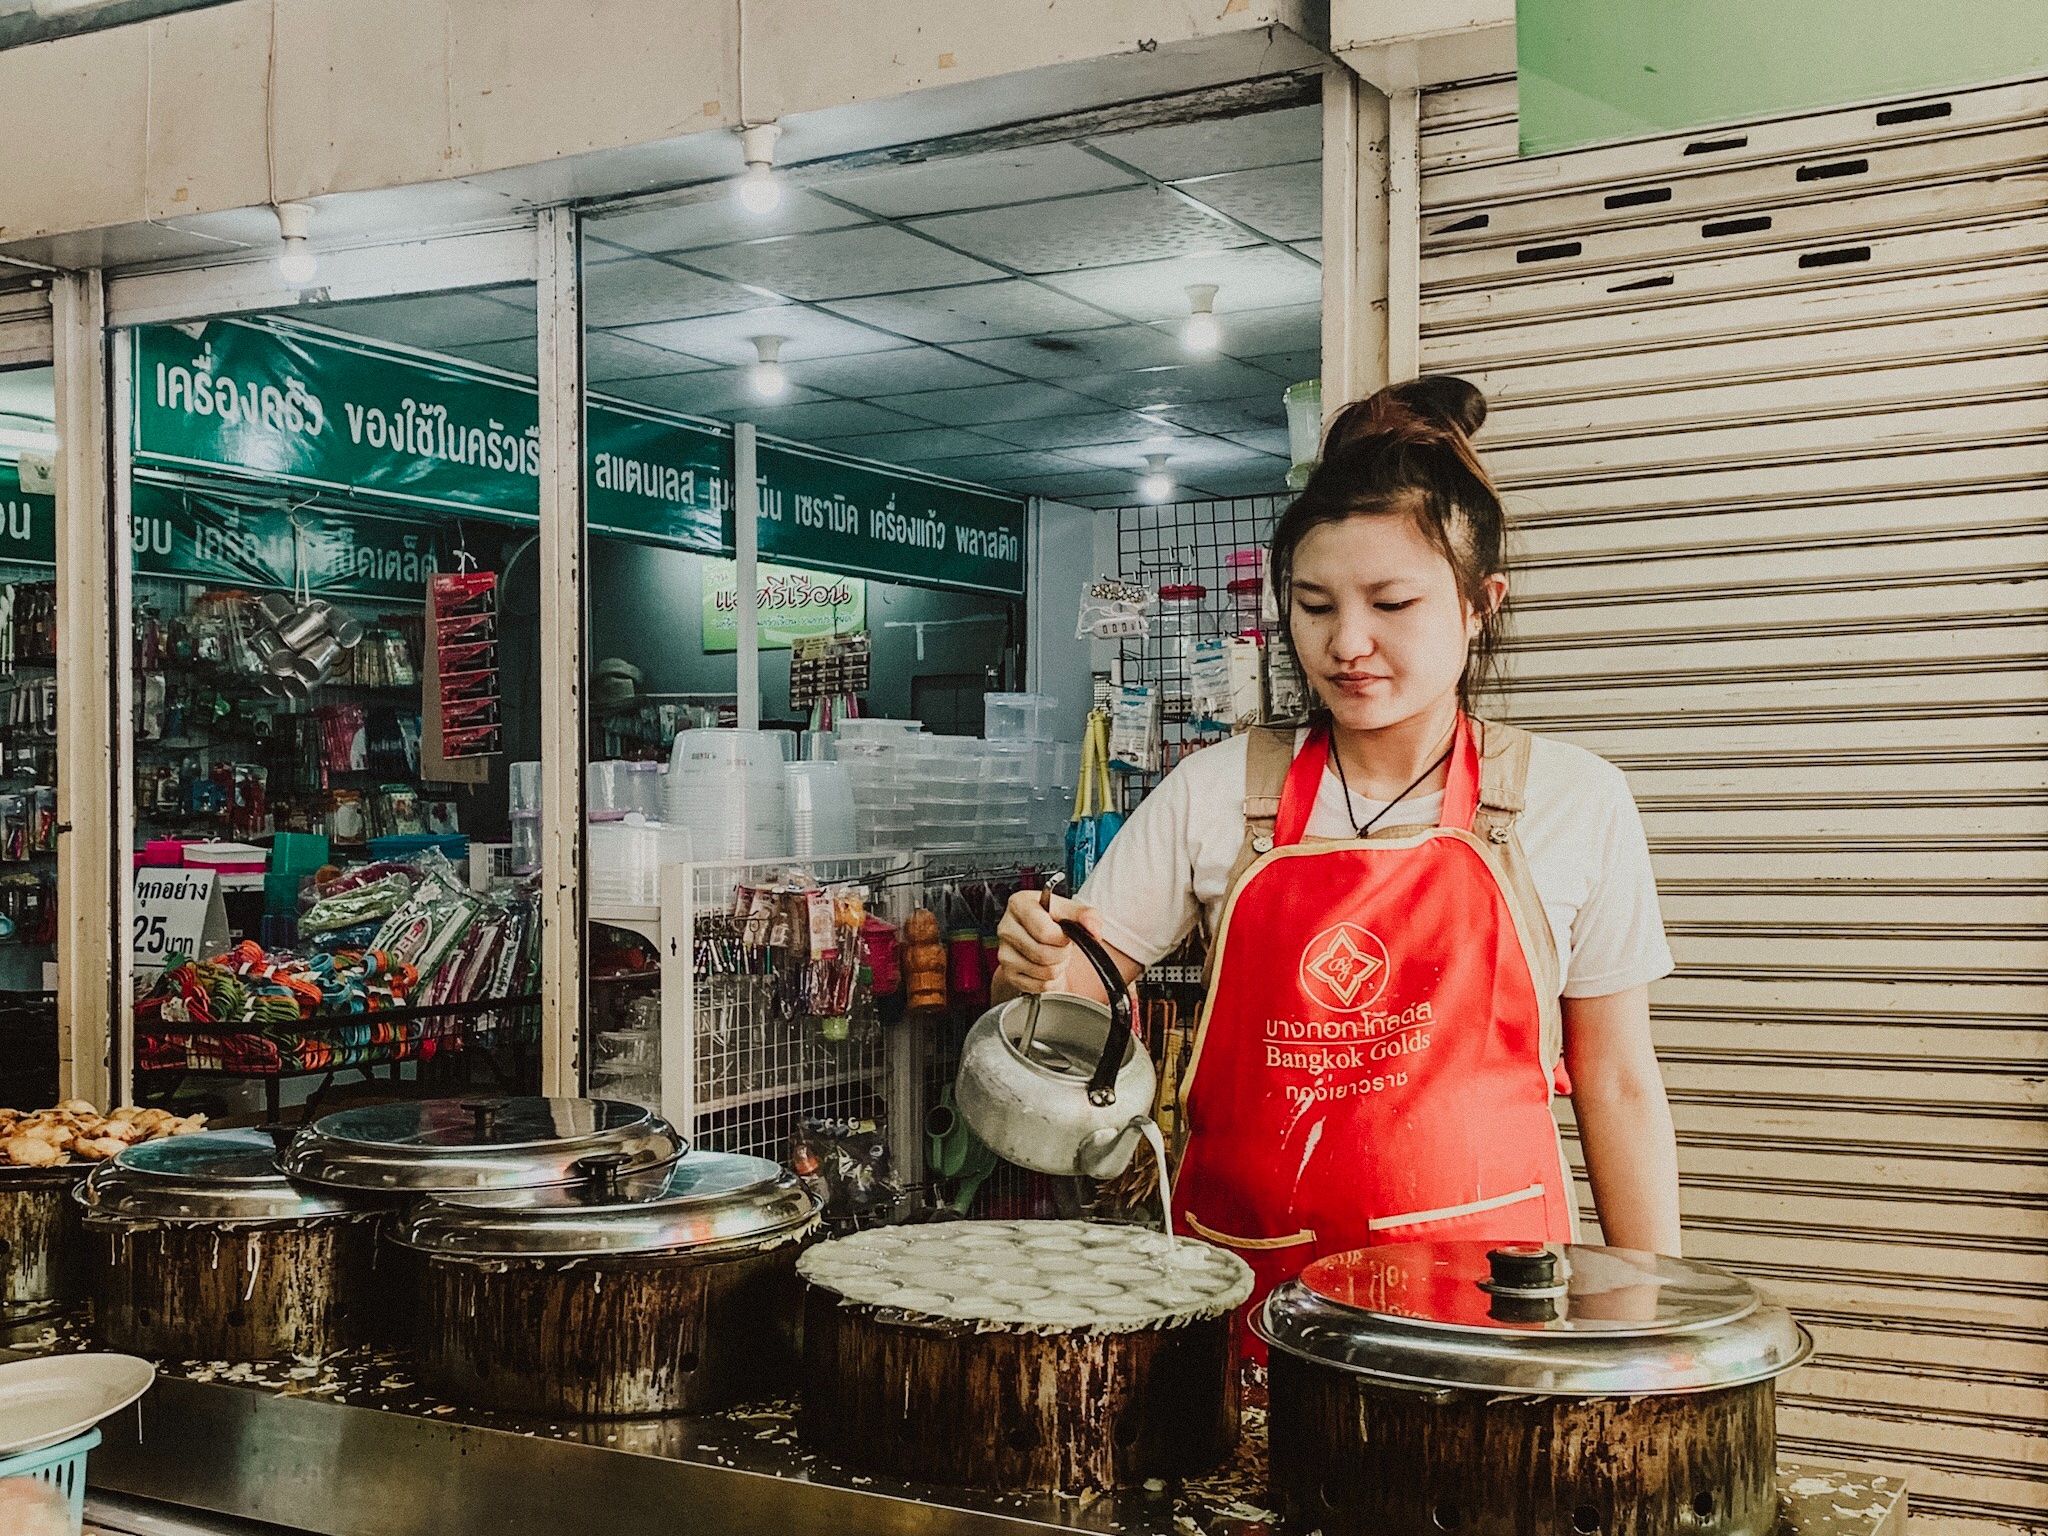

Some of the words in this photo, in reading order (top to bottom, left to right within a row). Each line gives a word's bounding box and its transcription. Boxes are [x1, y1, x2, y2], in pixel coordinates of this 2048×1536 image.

[156, 341, 324, 437] เครื่องครัว
[595, 451, 695, 504] สแตนเลส
[870, 492, 946, 550] เครื่องแก้ว
[955, 526, 1018, 563] พลาสติก
[137, 873, 208, 908] ทุกอย่าง
[1265, 1045, 1364, 1076] Bangkok
[1369, 1030, 1431, 1061] Golds
